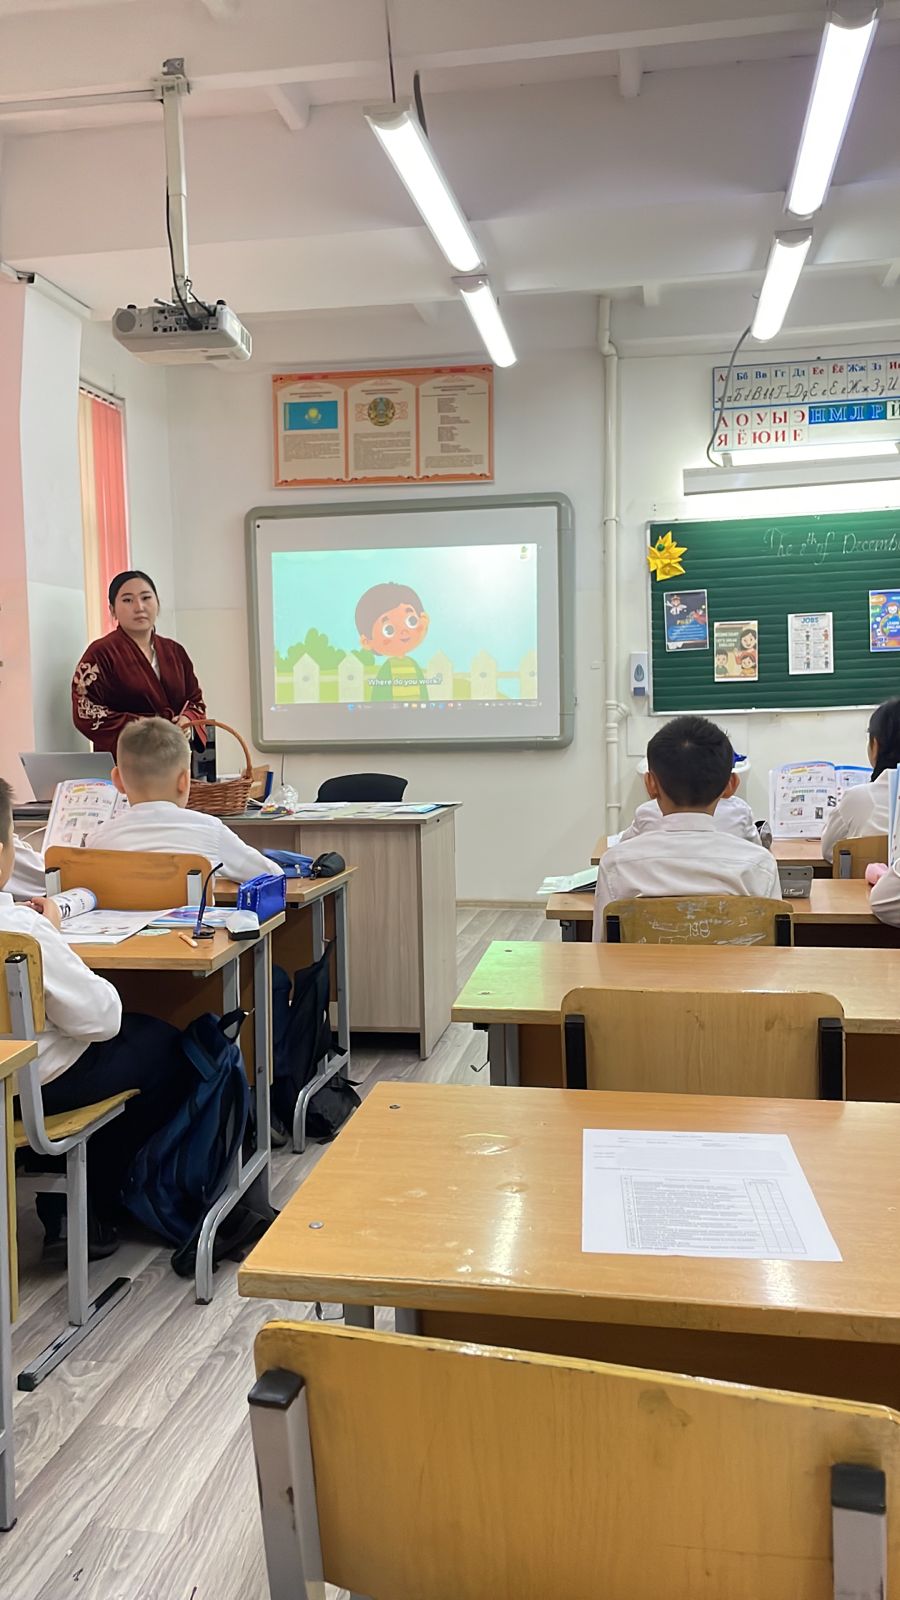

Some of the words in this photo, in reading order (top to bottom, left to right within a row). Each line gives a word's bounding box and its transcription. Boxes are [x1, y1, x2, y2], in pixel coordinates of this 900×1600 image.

[736, 372, 748, 381] Бб
[755, 370, 767, 379] Вв
[774, 369, 786, 378] Гг
[812, 367, 824, 375] Ее
[832, 363, 844, 374] Ёё
[848, 363, 866, 372] Жж
[735, 413, 749, 427] О
[756, 411, 768, 425] У
[772, 410, 788, 424] Ы
[793, 409, 806, 423] Э
[810, 407, 826, 423] Н
[828, 406, 848, 422] М
[849, 405, 864, 420] Л
[871, 404, 884, 419] Р
[717, 432, 728, 447] Я
[737, 428, 748, 445] Ё
[752, 430, 771, 444] Ю
[774, 429, 786, 442] И
[763, 527, 793, 557] The
[814, 531, 836, 566] of
[404, 679, 418, 687] you
[418, 674, 443, 685] work?
